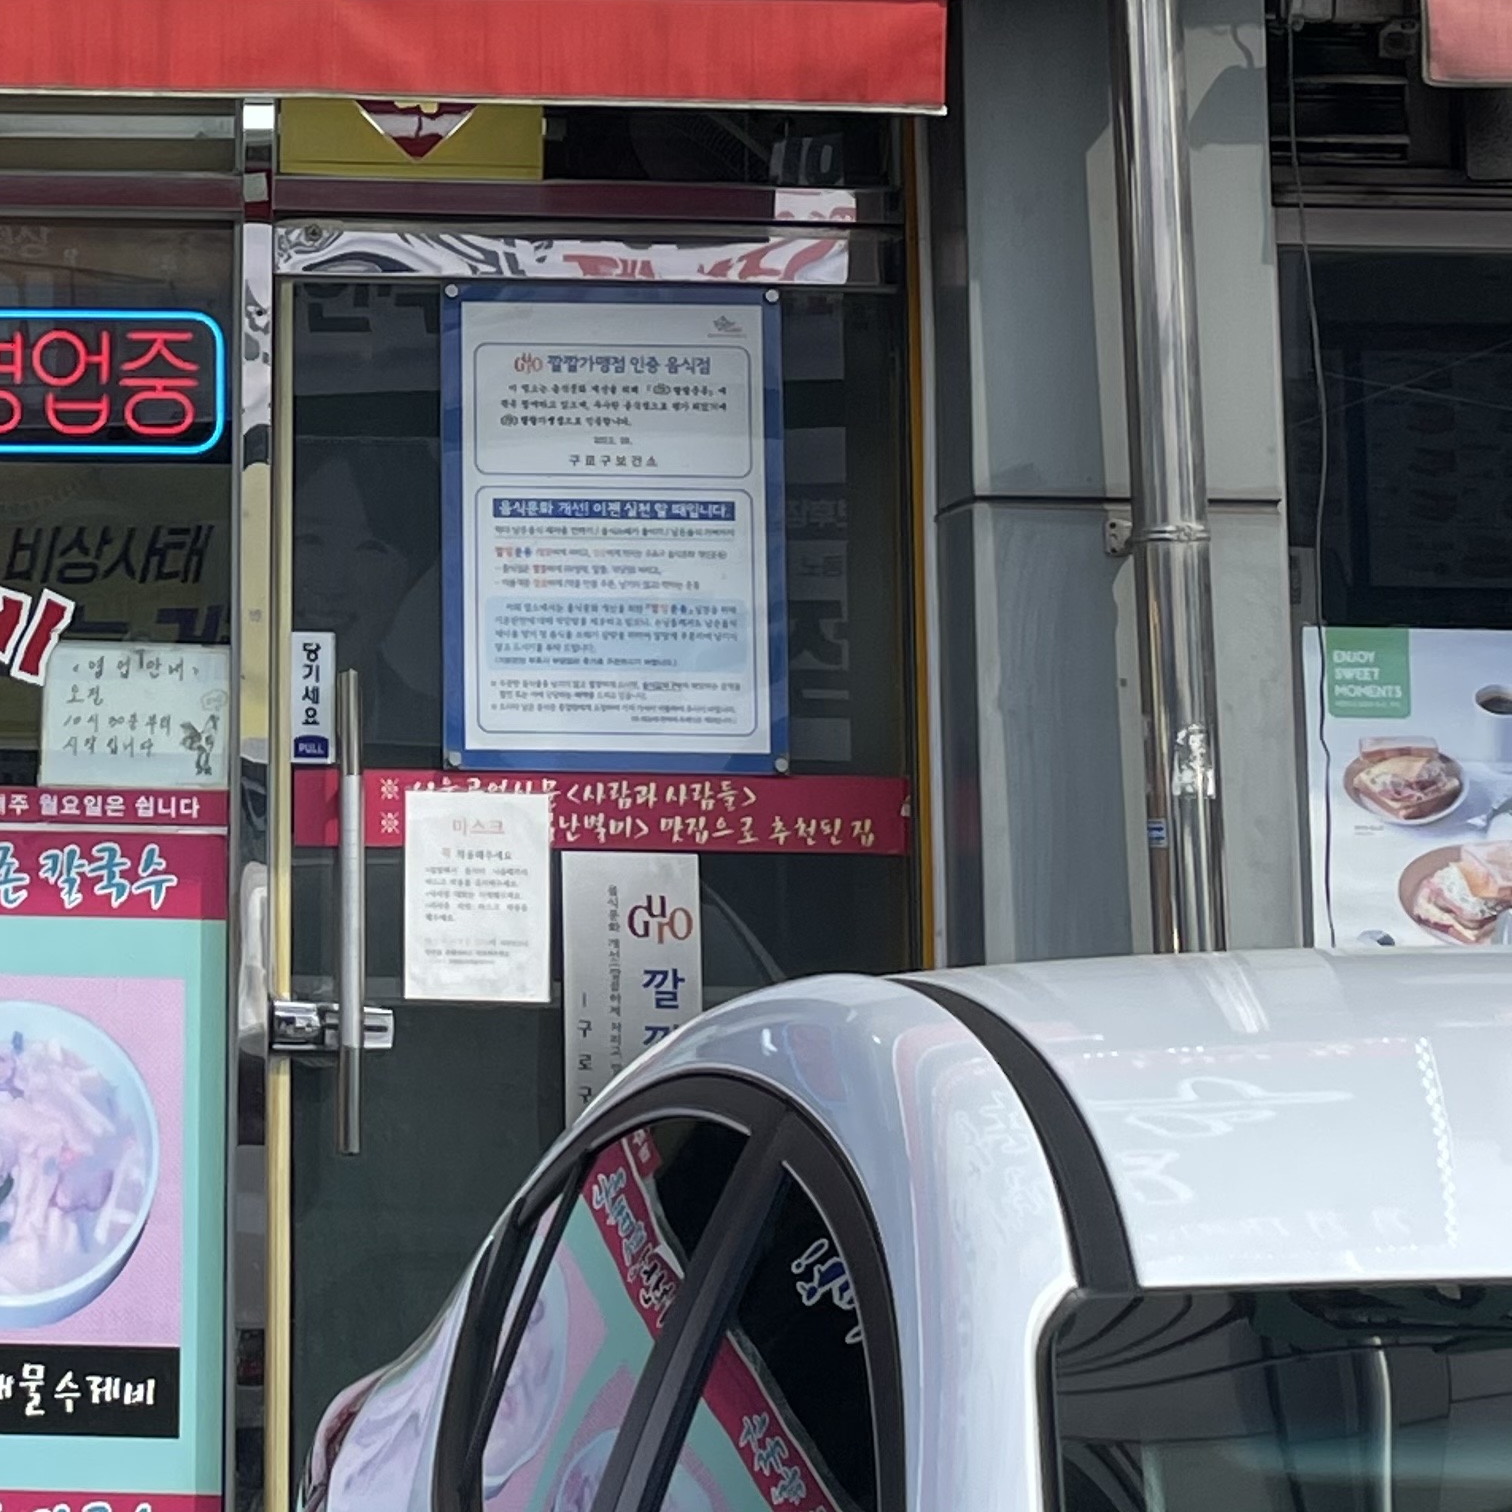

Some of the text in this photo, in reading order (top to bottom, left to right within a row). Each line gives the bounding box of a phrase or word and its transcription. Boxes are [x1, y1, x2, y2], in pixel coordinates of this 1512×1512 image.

[665, 357, 712, 375] 음식점
[1332, 650, 1376, 664] ENJOY
[1334, 667, 1381, 681] SWEET
[302, 642, 322, 727] 당기세요
[1334, 684, 1403, 698] MOMENTS
[298, 742, 325, 755] PULL
[40, 793, 126, 817] 월요일은
[135, 795, 200, 819] 쉽니다
[660, 815, 756, 845] 맛집으로
[769, 815, 843, 847] 추천된
[851, 818, 875, 847] 집
[39, 845, 178, 910] 칼국수
